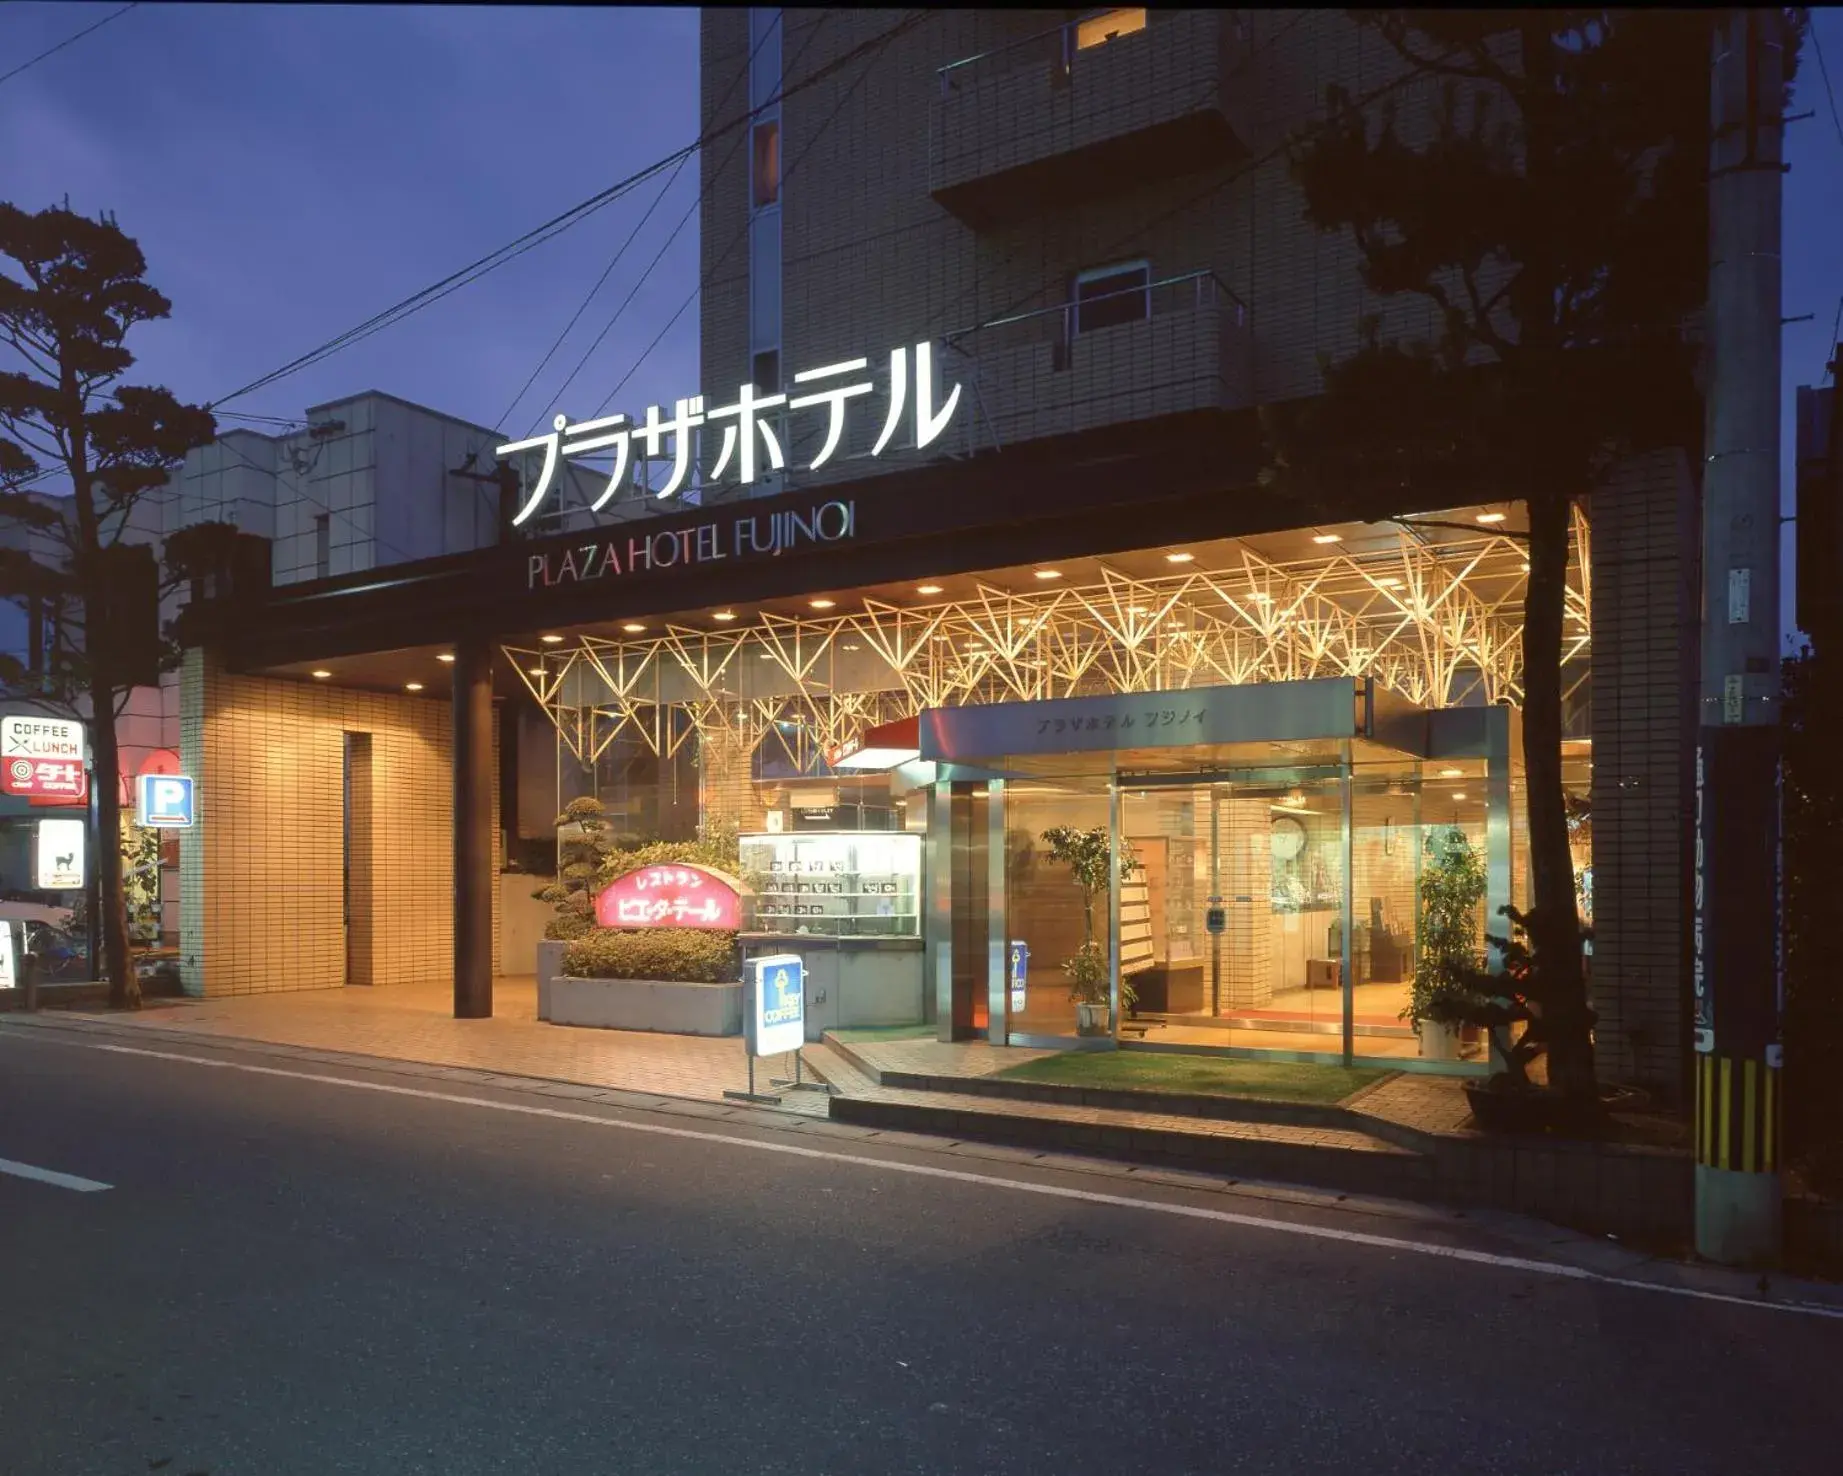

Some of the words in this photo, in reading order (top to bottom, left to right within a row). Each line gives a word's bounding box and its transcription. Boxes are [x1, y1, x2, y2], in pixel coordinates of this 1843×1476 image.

[495, 341, 962, 527] プラザホテル
[528, 544, 621, 589] PLAZA
[629, 523, 727, 574] HOTEL
[735, 500, 855, 556] FUJINOI
[14, 723, 69, 738] COFFEE
[1036, 714, 1136, 735] プラザホテル
[33, 741, 78, 755] LUNCH
[154, 780, 186, 814] P
[635, 870, 704, 891] レストラン
